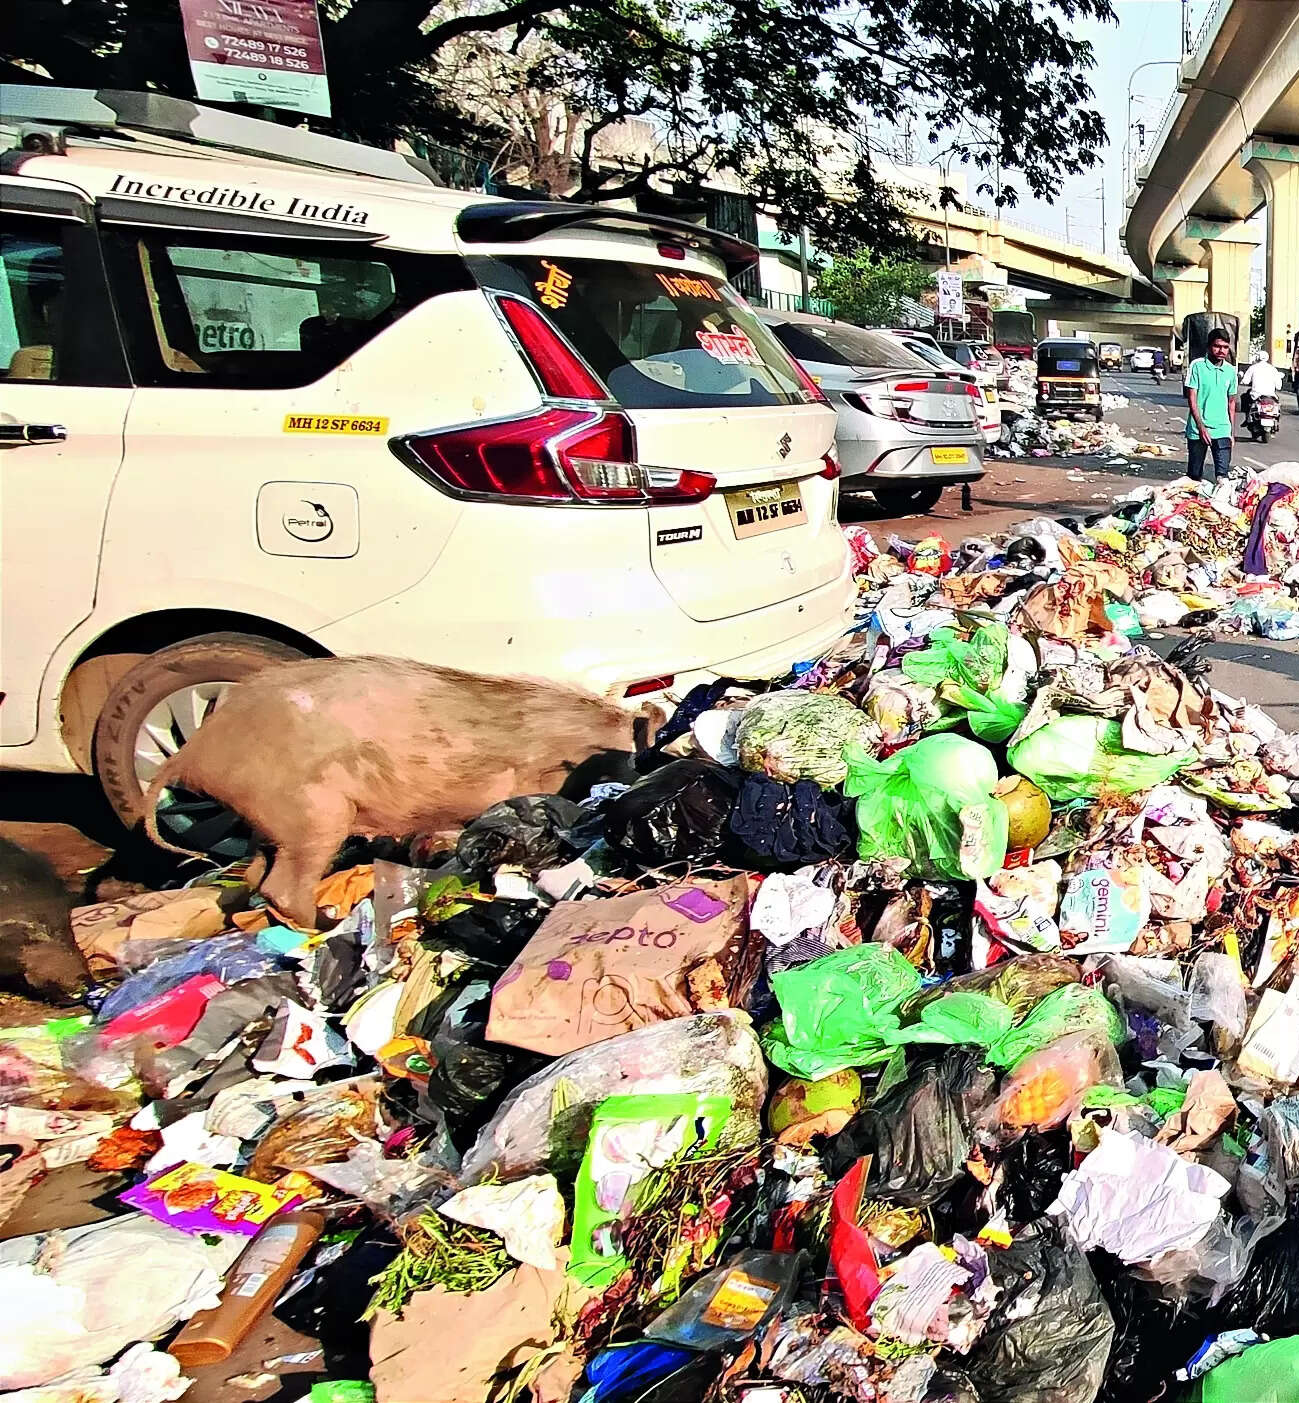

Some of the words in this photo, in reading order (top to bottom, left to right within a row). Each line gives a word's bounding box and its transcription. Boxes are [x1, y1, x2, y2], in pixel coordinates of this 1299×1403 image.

[220, 34, 265, 51] 72489
[267, 43, 281, 53] 17
[283, 46, 308, 58] 526
[223, 47, 268, 63] 72489
[268, 55, 283, 66] 18
[285, 58, 310, 70] 526
[109, 174, 276, 212] Incredible
[287, 197, 370, 225] India
[288, 417, 311, 430] MH
[312, 418, 329, 430] 12
[330, 418, 350, 431] SF
[350, 420, 381, 432] 6634
[287, 518, 327, 527] Petrol
[658, 531, 689, 542] TOUR
